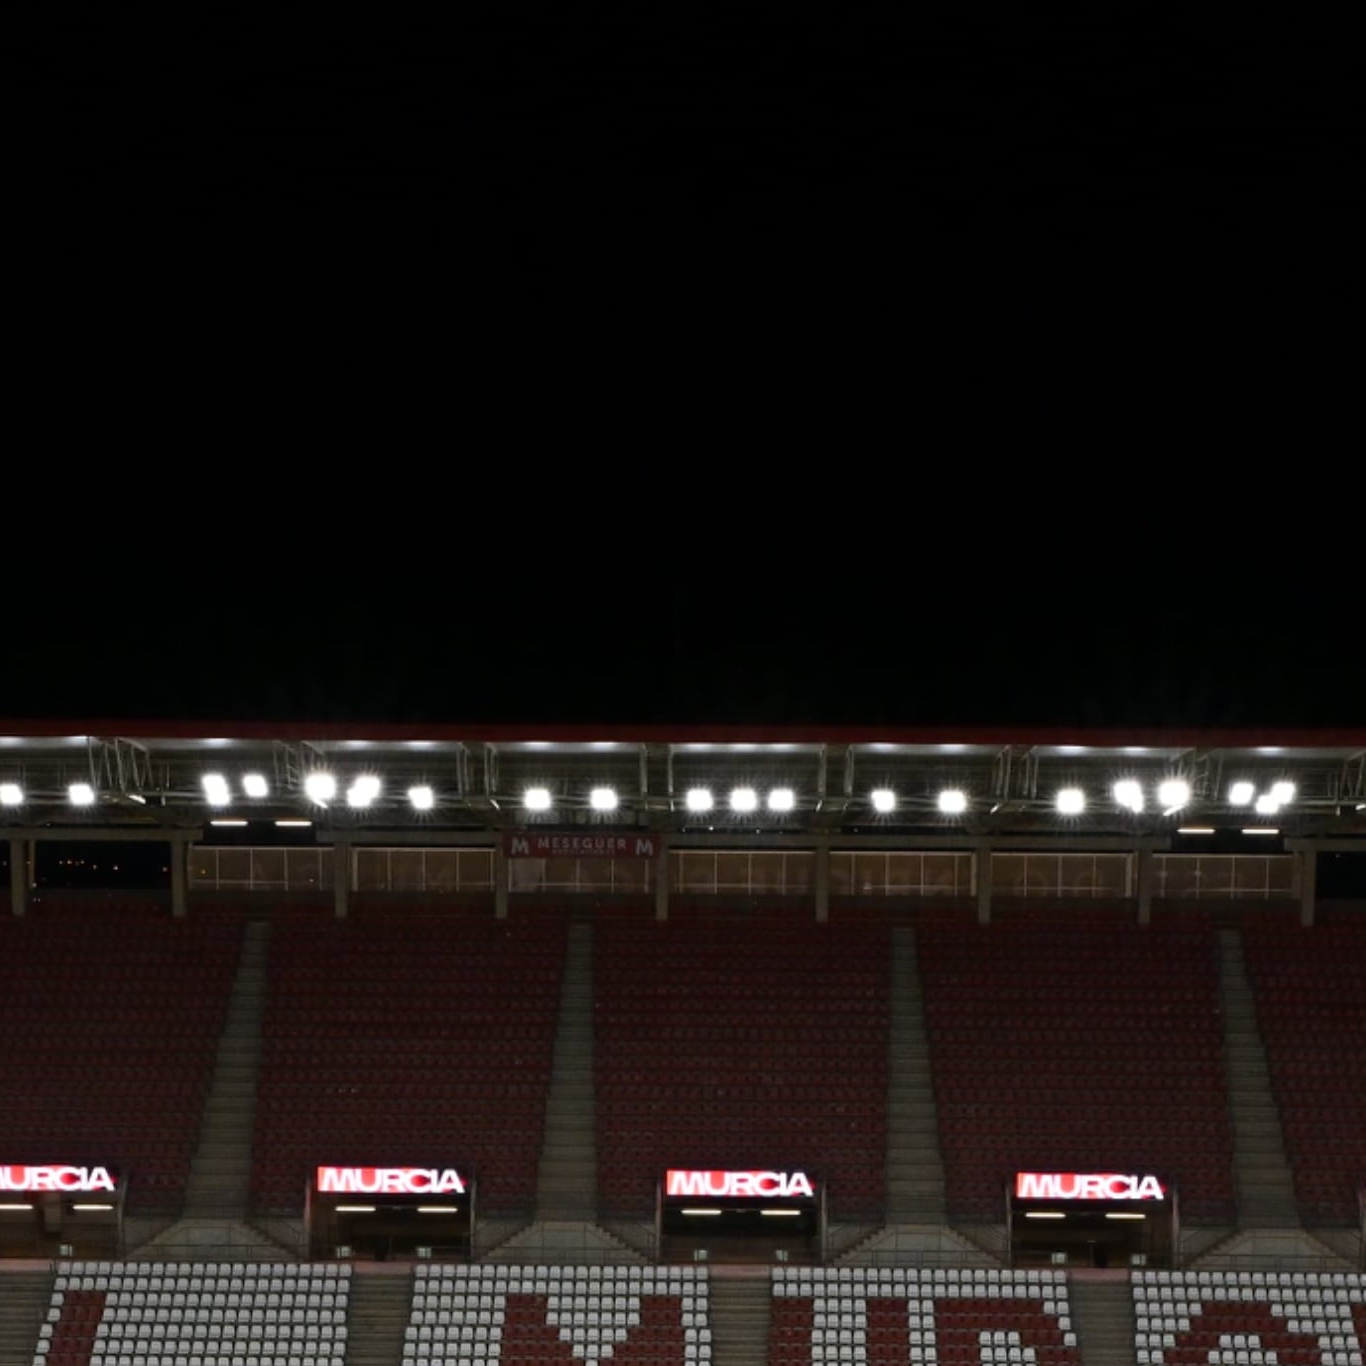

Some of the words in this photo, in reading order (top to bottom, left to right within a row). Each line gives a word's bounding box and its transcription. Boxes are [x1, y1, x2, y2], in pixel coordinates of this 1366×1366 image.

[538, 837, 627, 849] MESEGUER
[321, 1168, 464, 1192] MURCIA
[672, 1172, 813, 1196] MURCIA
[1019, 1174, 1163, 1199] MURCIA
